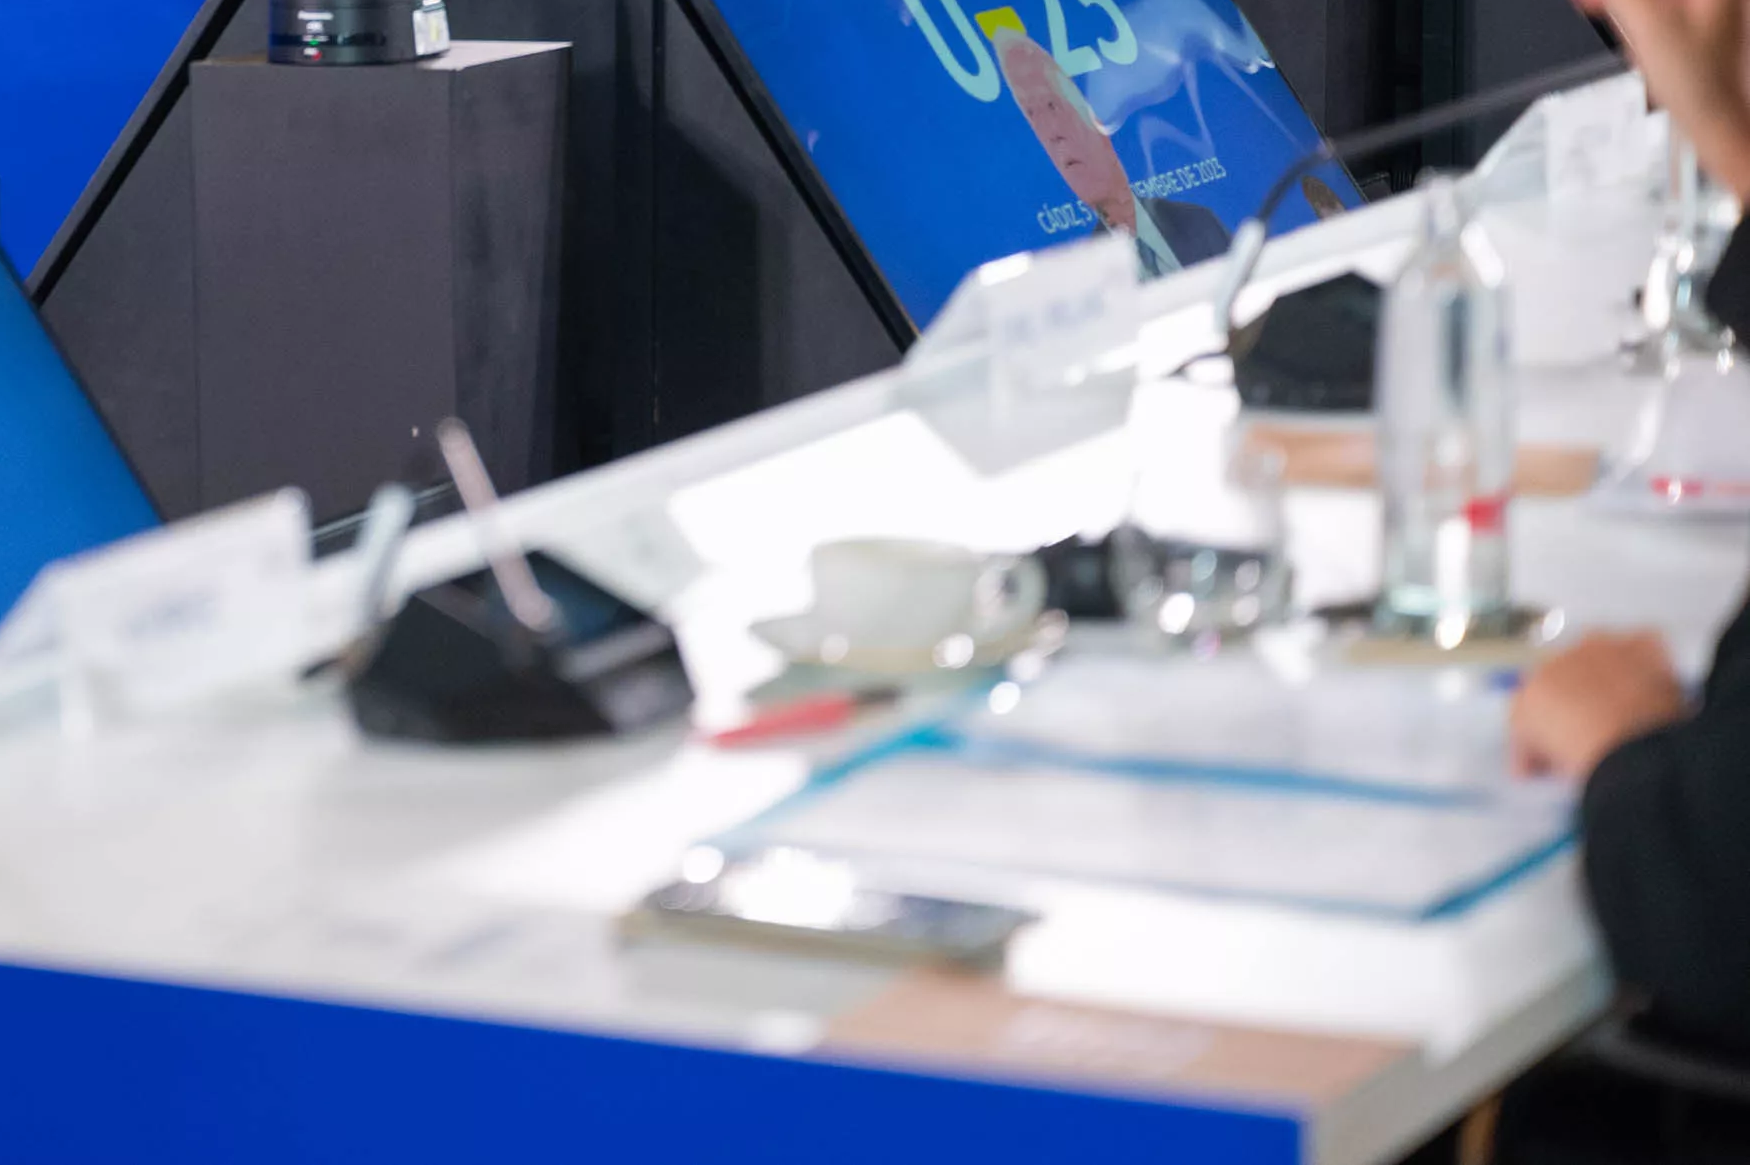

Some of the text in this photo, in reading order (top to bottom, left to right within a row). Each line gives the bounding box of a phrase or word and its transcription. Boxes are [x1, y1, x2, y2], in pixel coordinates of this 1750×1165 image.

[1036, 203, 1086, 234] CÁDIZ,
[1175, 164, 1201, 189] DE
[1193, 156, 1227, 183] 2023
